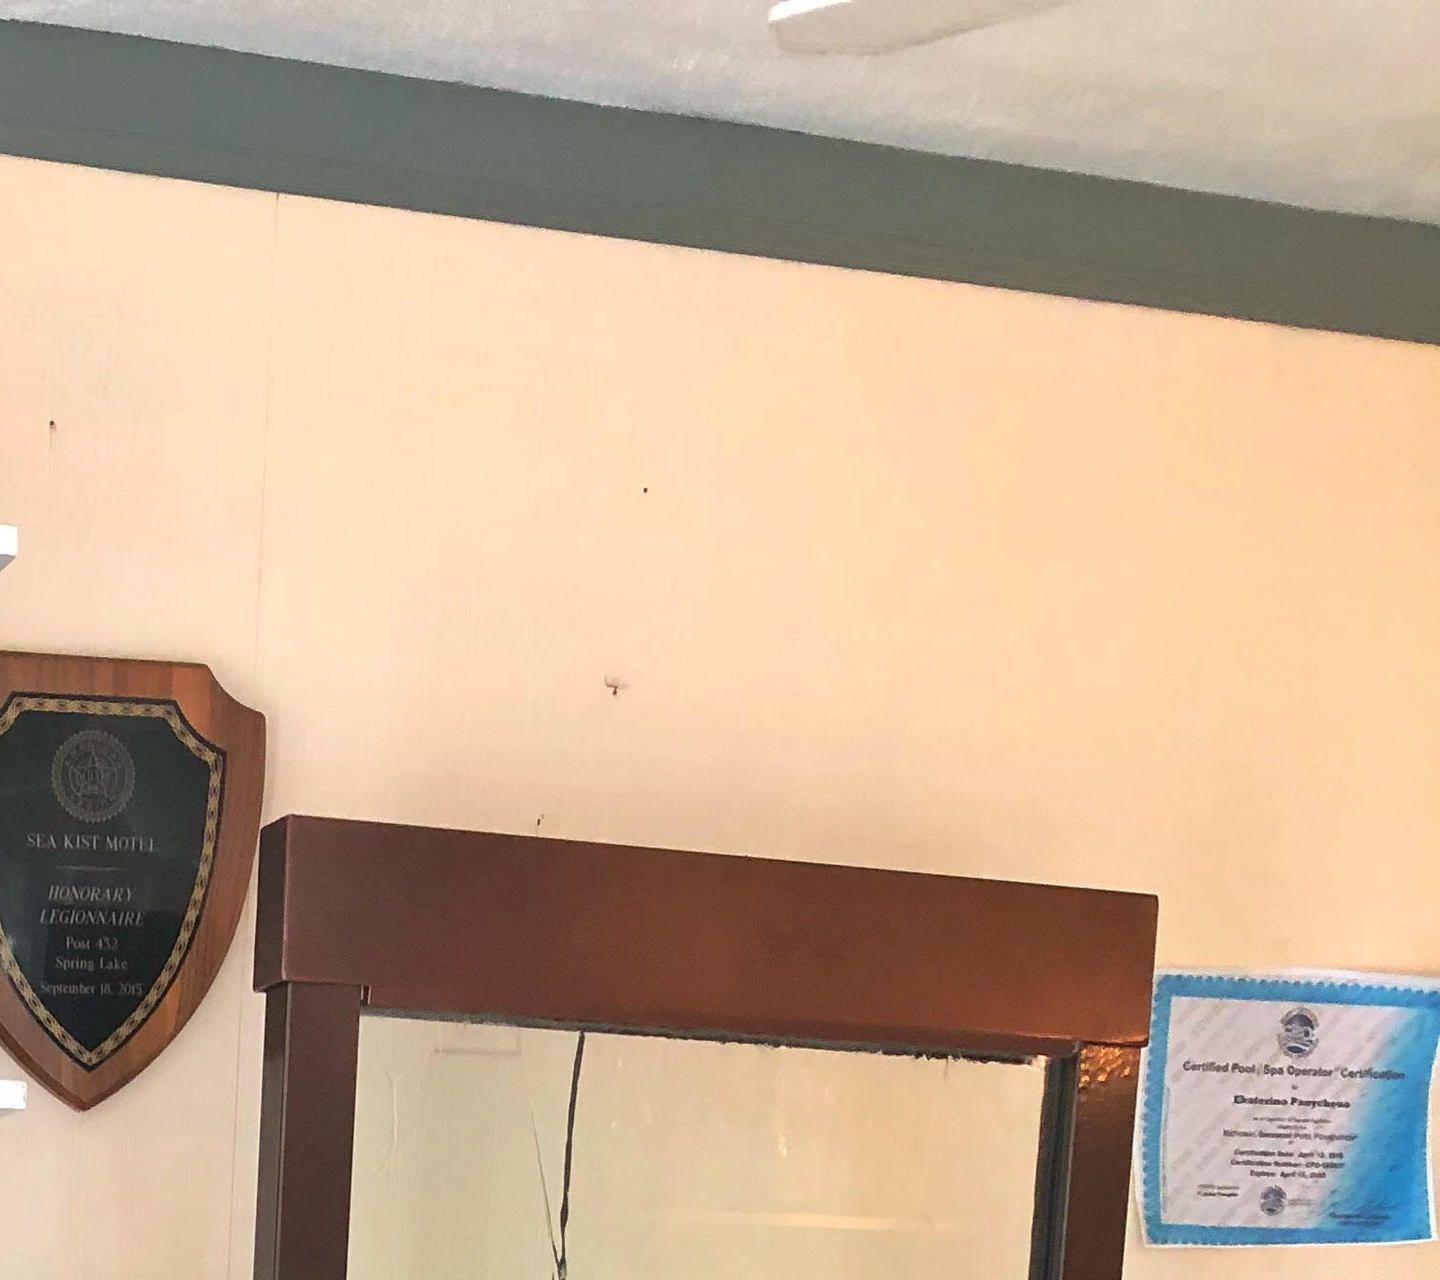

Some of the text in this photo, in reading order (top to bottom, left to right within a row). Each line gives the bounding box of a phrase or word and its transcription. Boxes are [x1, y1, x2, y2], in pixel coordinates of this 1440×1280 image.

[26, 834, 156, 853] SEA KIST MOTEL
[48, 885, 135, 902] HONORARY
[40, 910, 145, 928] LEGIONNAIRE
[55, 958, 128, 972] Spring Lake
[1183, 1061, 1229, 1074] Certified
[1231, 1063, 1255, 1074] Pool
[1287, 1066, 1333, 1078] Operator
[1341, 1068, 1406, 1081] Certification
